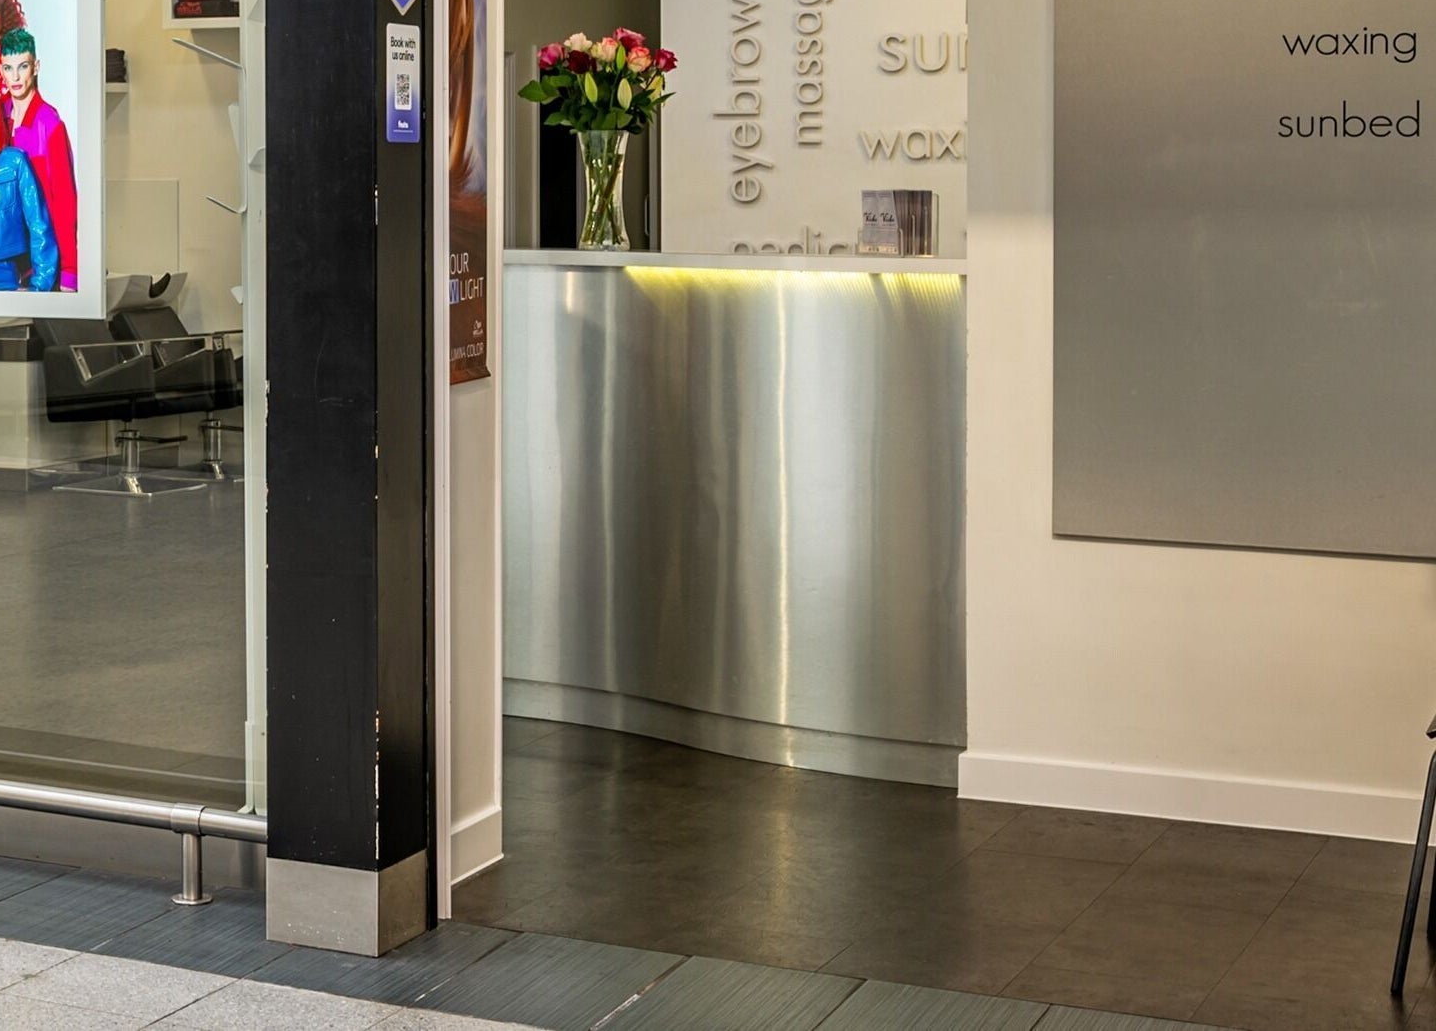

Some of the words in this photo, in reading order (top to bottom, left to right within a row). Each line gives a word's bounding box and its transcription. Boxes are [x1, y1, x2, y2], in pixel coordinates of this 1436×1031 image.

[390, 35, 405, 49] Book
[405, 37, 417, 50] with
[1282, 26, 1418, 64] waxing
[392, 52, 399, 61] us
[399, 50, 415, 62] online
[1277, 100, 1421, 138] sunbed
[450, 252, 469, 274] OUR
[459, 277, 484, 301] LIGHT
[466, 342, 485, 358] COLOR
